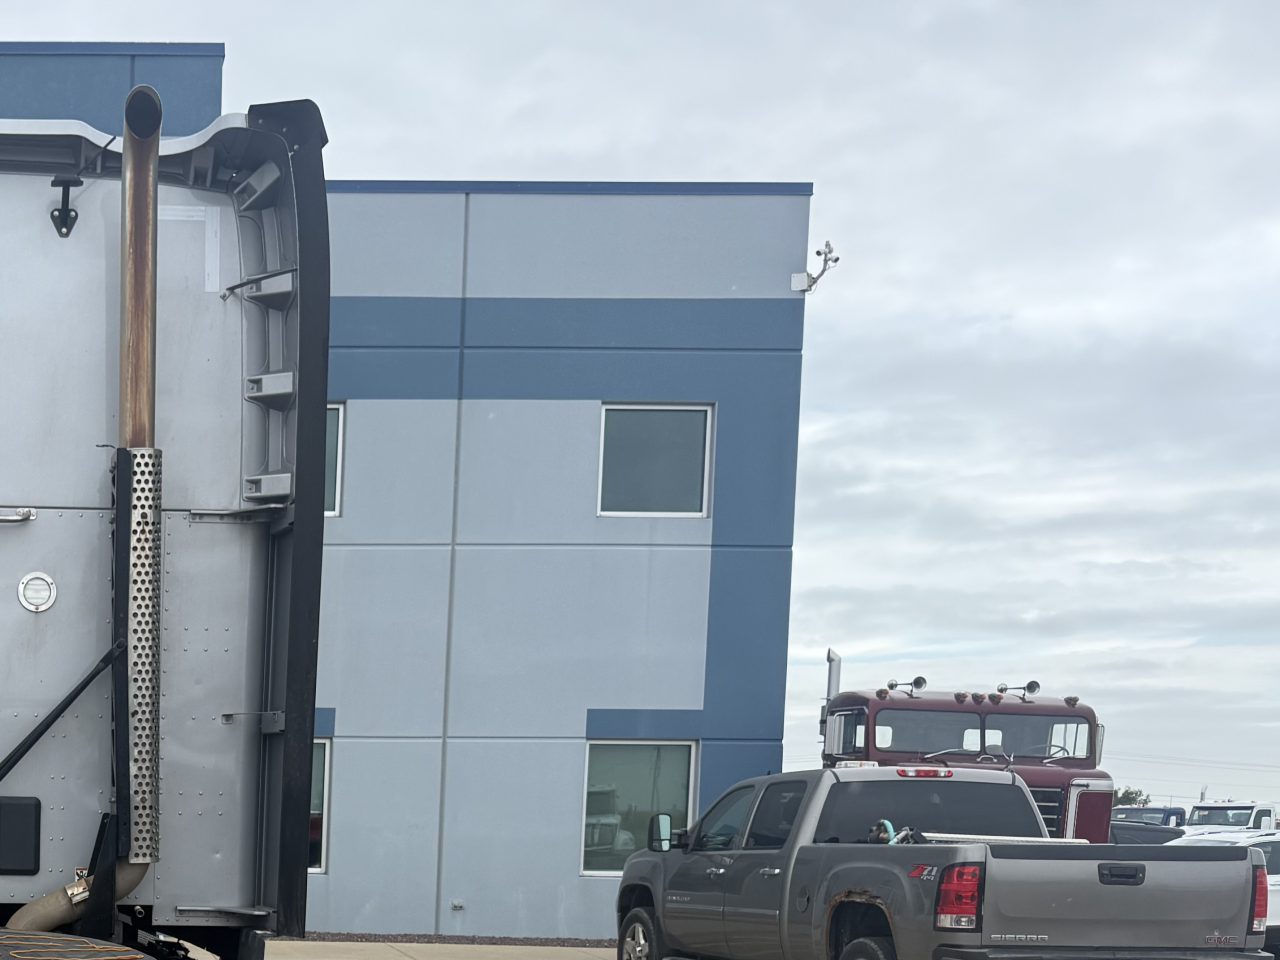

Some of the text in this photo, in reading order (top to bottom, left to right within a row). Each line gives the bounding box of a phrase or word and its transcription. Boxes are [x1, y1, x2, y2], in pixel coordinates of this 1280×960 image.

[907, 864, 938, 877] Z71
[991, 934, 1048, 942] SIERRA
[1206, 935, 1239, 944] GMC
